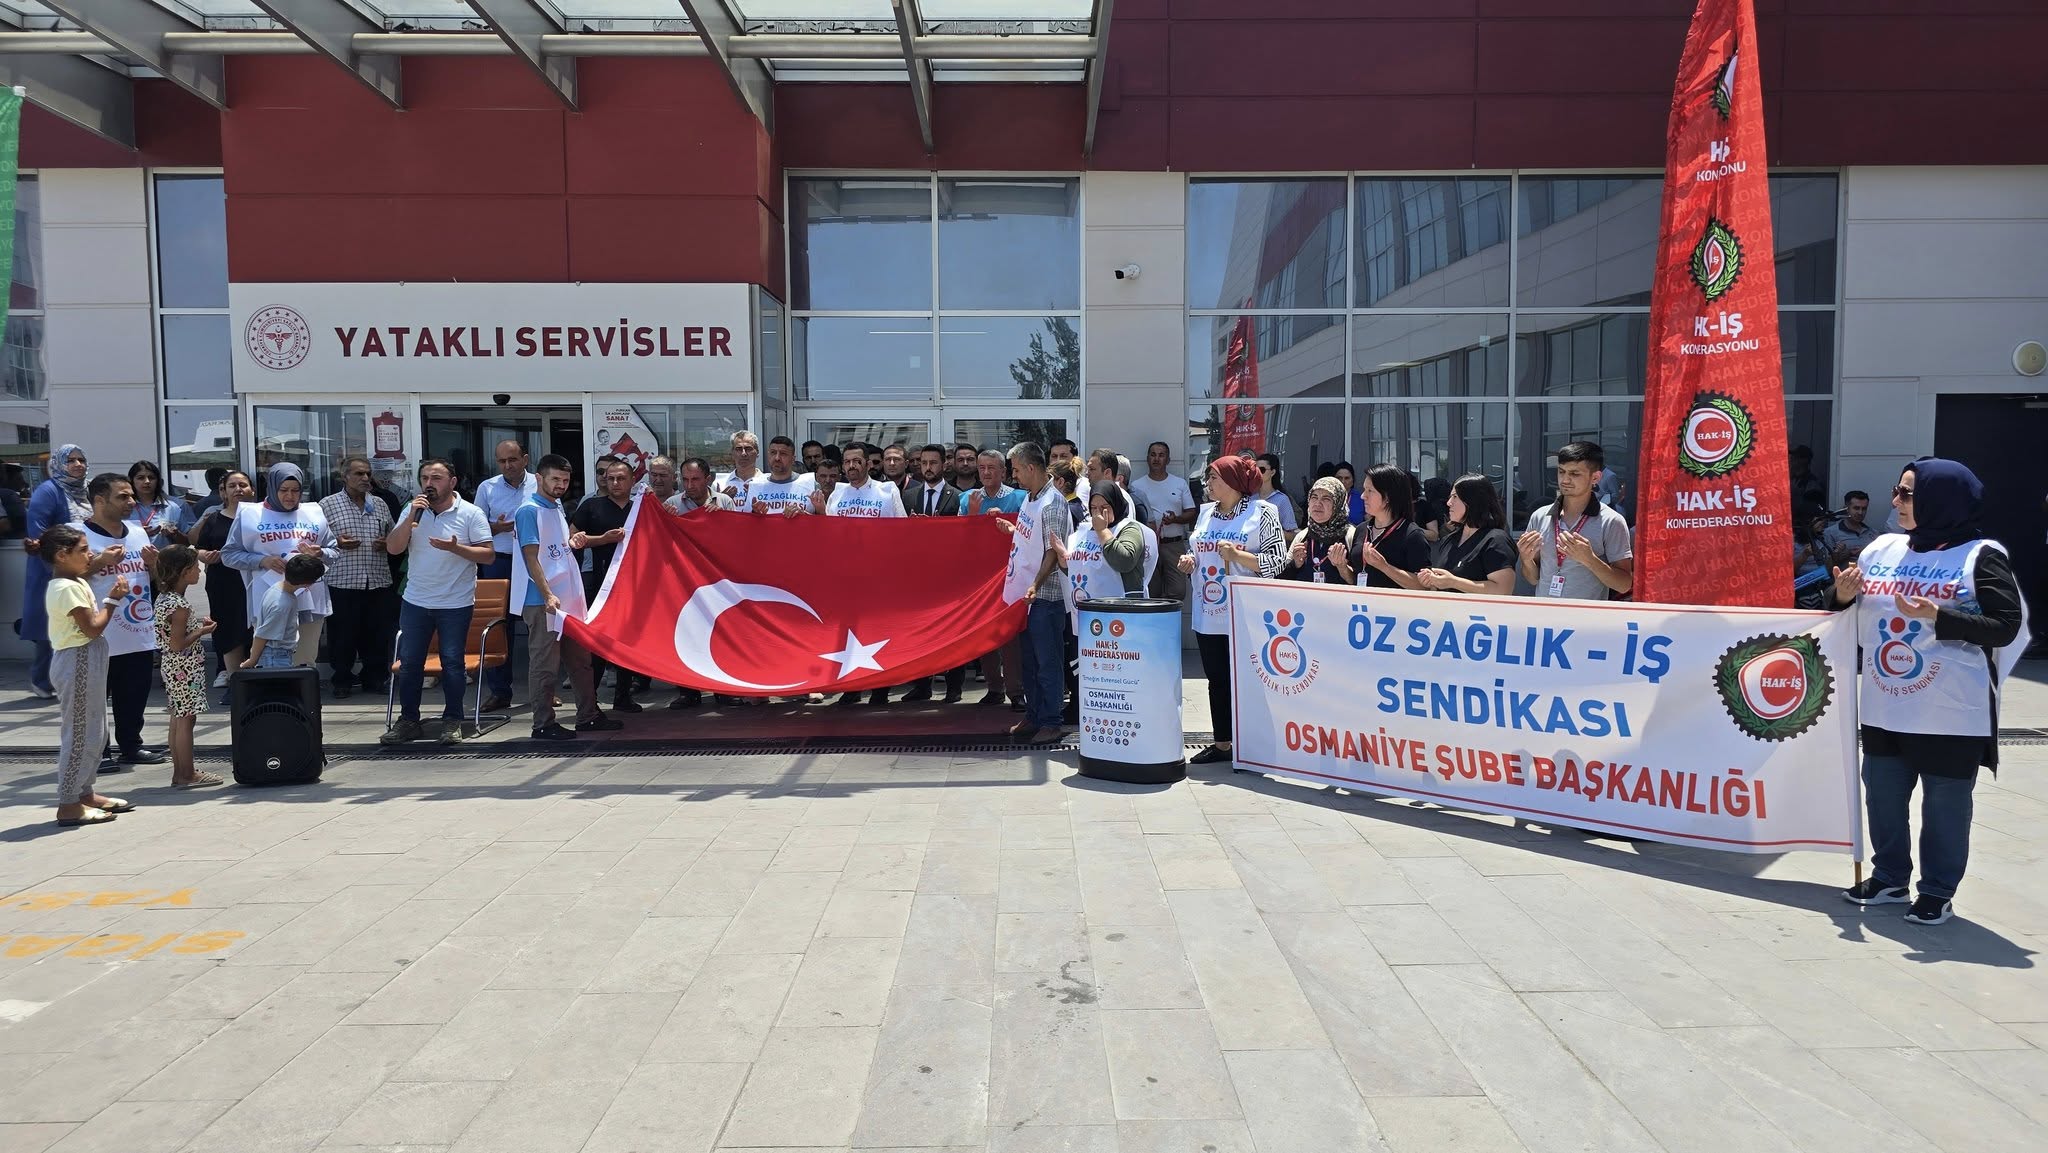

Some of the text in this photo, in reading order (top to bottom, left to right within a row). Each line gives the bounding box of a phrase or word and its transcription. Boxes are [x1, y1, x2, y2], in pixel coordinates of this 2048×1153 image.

[1694, 311, 1743, 339] HK-İŞ
[334, 318, 732, 358] YATAKLI SERVİSLER
[1697, 430, 1731, 440] HAK-İŞ
[1676, 485, 1757, 512] HAK-İŞ
[257, 520, 320, 532] ÖZ SAĞLIK-İŞ
[1666, 514, 1773, 529] KONFEDERASYONU
[260, 530, 319, 543] SENDİKASI
[1208, 530, 1249, 544] AĞLIK-İŞ
[1868, 562, 1891, 577] ÖZ
[1861, 577, 1960, 600] SENDİKASI
[1095, 640, 1119, 650] HAK-İŞ
[1347, 604, 1674, 684] ÖZ SAĞLIK - İŞ
[1081, 649, 1140, 660] KONFEDERASYONU
[1890, 655, 1913, 663] HAK-İŞ
[1255, 667, 1279, 692] SAĞLIK
[1291, 659, 1320, 694] SENDİKASI
[1761, 675, 1802, 690] HAK-İŞ
[1902, 661, 1941, 695] SENDİKASI
[1088, 690, 1126, 701] OSMANİYE
[1090, 700, 1133, 711] BAŞKANLIĞI
[1376, 677, 1632, 738] SENDİKASI
[1285, 721, 1767, 819] OSMANİYE ŞUBE BAŞKANLIĞI
